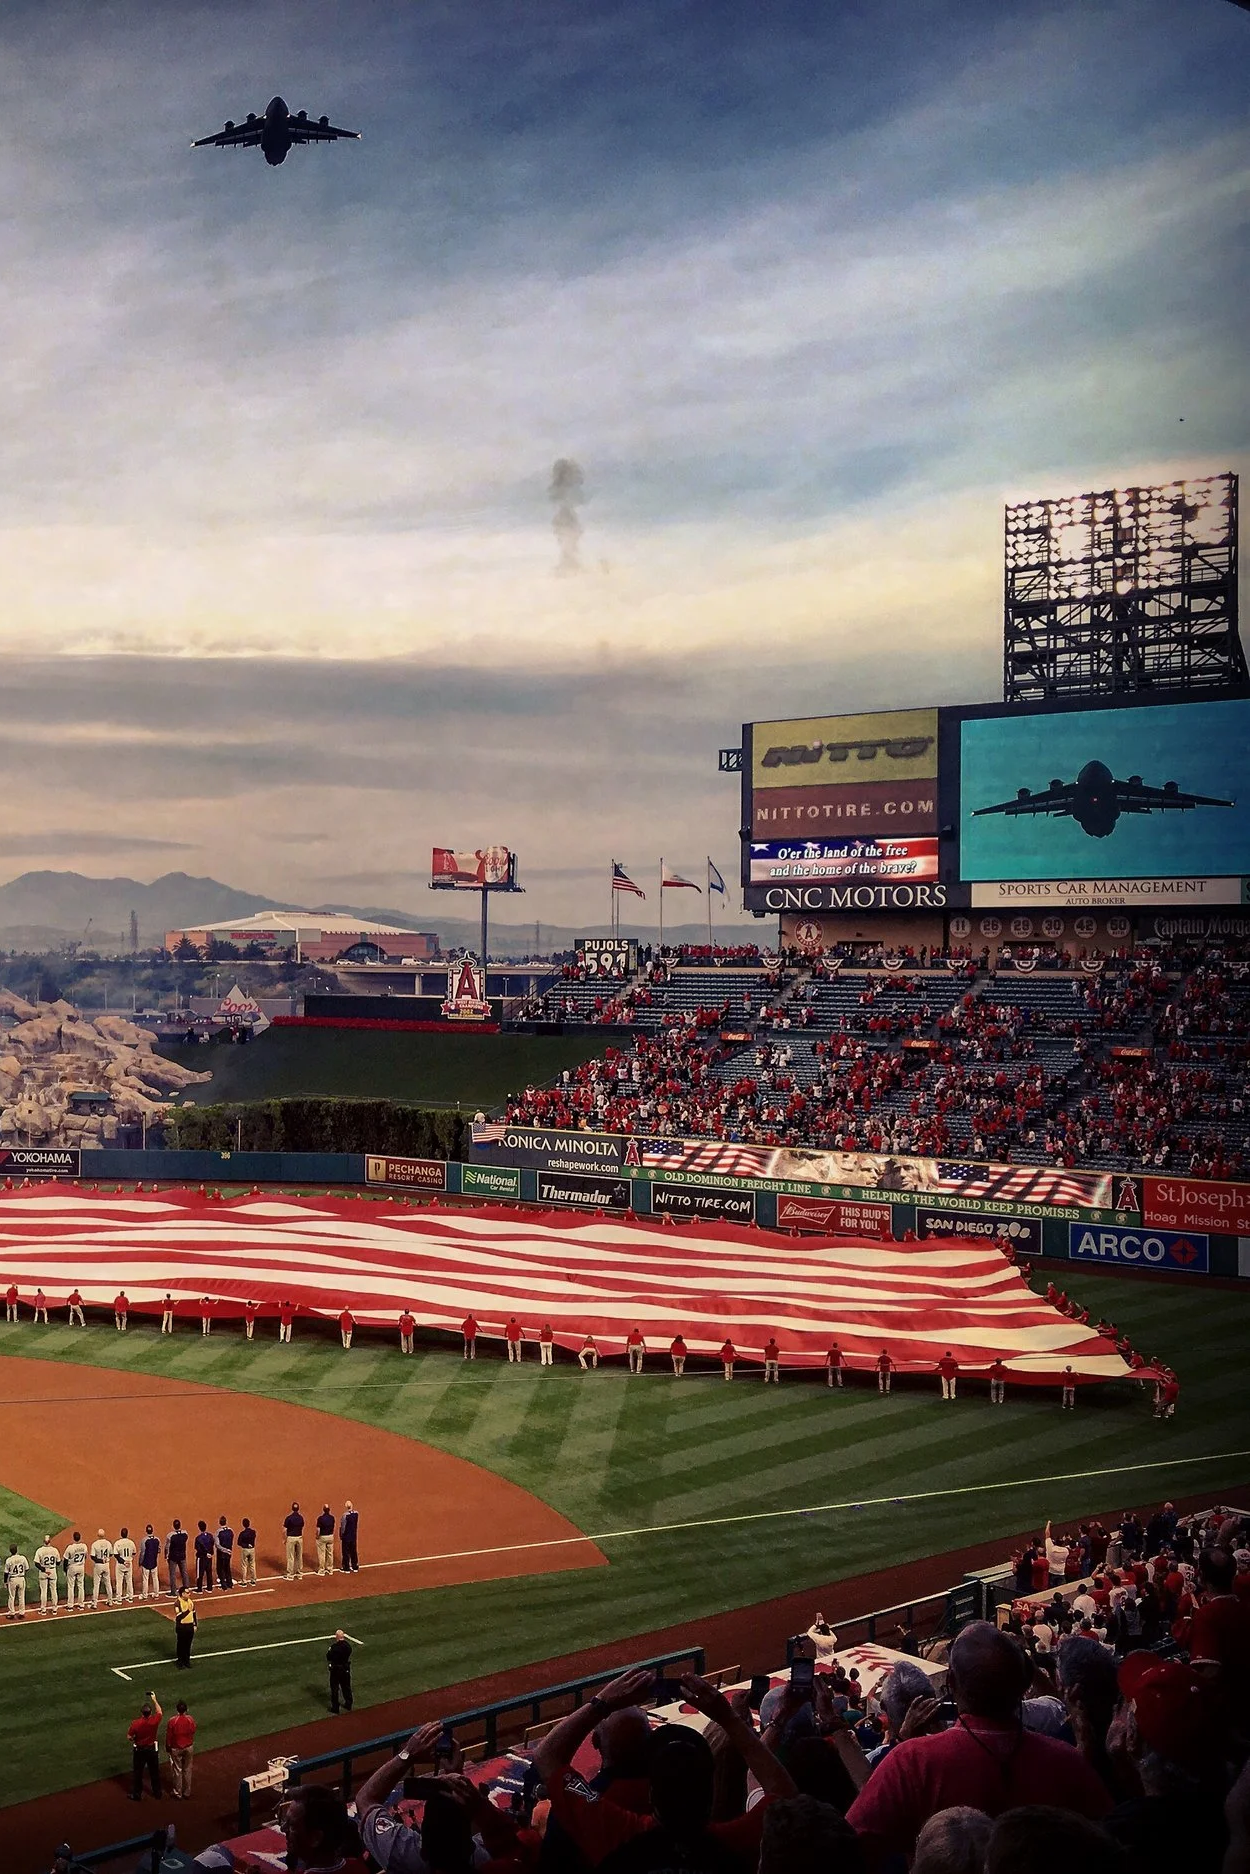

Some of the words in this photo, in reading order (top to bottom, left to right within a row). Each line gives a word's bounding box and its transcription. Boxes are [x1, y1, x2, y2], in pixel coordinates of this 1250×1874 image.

[778, 848, 801, 858] O'er
[804, 847, 821, 858] the
[824, 847, 846, 858] land
[851, 846, 864, 857] of
[865, 846, 882, 857] the
[885, 845, 907, 857] free
[770, 865, 790, 876] and
[793, 865, 809, 876] the
[812, 864, 841, 876] home
[845, 863, 858, 875] of
[859, 863, 876, 874] the
[880, 862, 917, 874] brave?
[766, 887, 822, 909] CNC
[829, 885, 947, 908] MOTORS
[1065, 897, 1090, 905] AUTO
[1092, 897, 1125, 905] BROKER
[956, 920, 965, 931] 11
[984, 919, 999, 931] 26
[1014, 919, 1029, 931] 29
[1045, 919, 1061, 931] 30
[1076, 919, 1093, 931] 42
[1154, 917, 1204, 938] Captain
[1204, 916, 1250, 938] Morga
[585, 941, 629, 950] PUJOLS
[586, 953, 626, 975] 591
[555, 1139, 618, 1157] MINOLTA
[12, 1152, 72, 1163] YOKOHAMA
[389, 1164, 442, 1178] PECHANGA
[547, 1158, 619, 1174] reshapework.com
[388, 1173, 414, 1181] RESORT
[418, 1176, 443, 1184] CASINO
[664, 1171, 685, 1182] OLD
[687, 1173, 738, 1187] DOMINION
[741, 1178, 785, 1192] FREIGHT
[788, 1183, 811, 1195] LINE
[541, 1185, 611, 1205] Thermador
[656, 1193, 691, 1206] NITTO
[694, 1196, 751, 1213] TIRE.COM
[862, 1189, 910, 1204] HELPING
[913, 1195, 935, 1206] THE
[938, 1197, 983, 1210] WORLD
[984, 1201, 1014, 1213] KEEP
[1017, 1205, 1080, 1219] PROMISES
[784, 1206, 830, 1219] Budweiser
[840, 1207, 861, 1217] THIS
[863, 1208, 890, 1220] BUD'S
[840, 1217, 858, 1228] FOR
[859, 1219, 880, 1231] YOU.
[926, 1218, 953, 1230] SAN
[955, 1221, 994, 1234] DIEGO
[1144, 1211, 1177, 1225] Hoag
[1184, 1214, 1229, 1229] Mission
[1078, 1232, 1165, 1262] ARCO
[73, 1552, 85, 1563] 27
[100, 1548, 108, 1558] 14
[123, 1548, 130, 1558] 11
[43, 1555, 55, 1566] 29
[12, 1564, 24, 1574] 43
